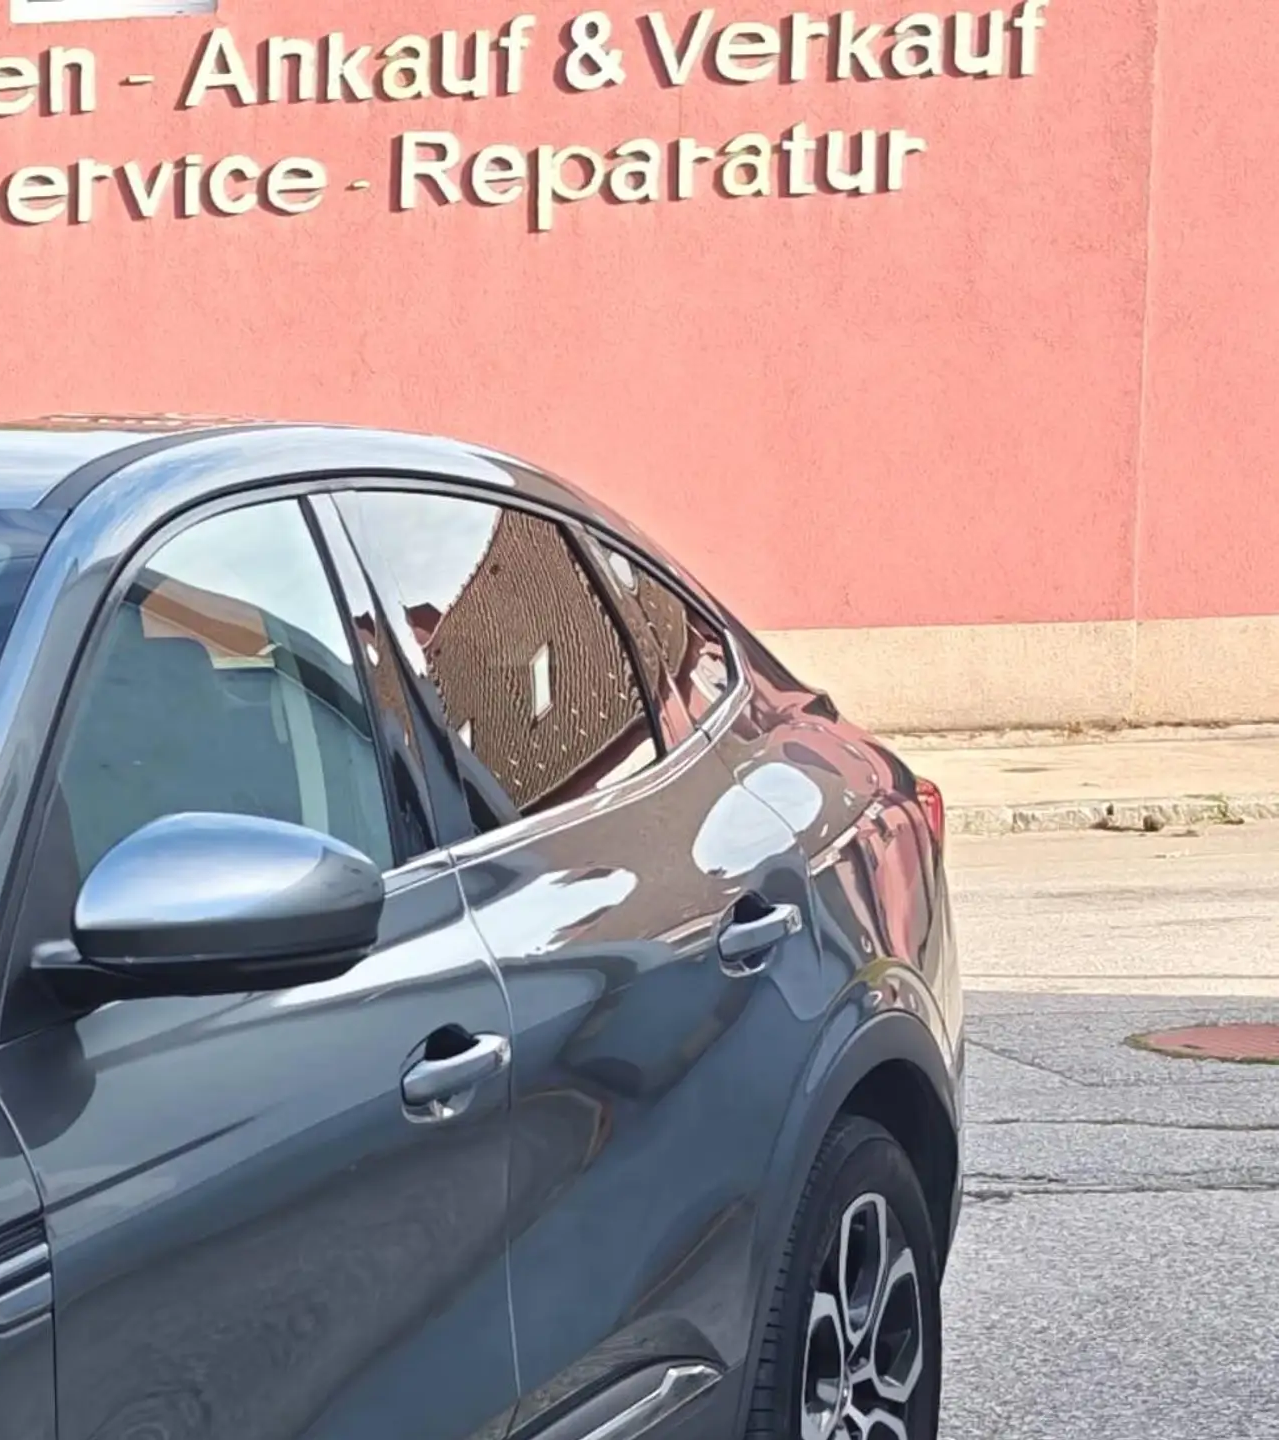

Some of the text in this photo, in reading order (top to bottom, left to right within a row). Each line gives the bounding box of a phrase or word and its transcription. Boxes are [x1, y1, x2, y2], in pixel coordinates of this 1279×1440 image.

[184, 14, 537, 107] Ankauf
[565, 11, 625, 91] &
[644, 0, 1046, 86] Verkauf
[398, 121, 929, 231] Reparatur
